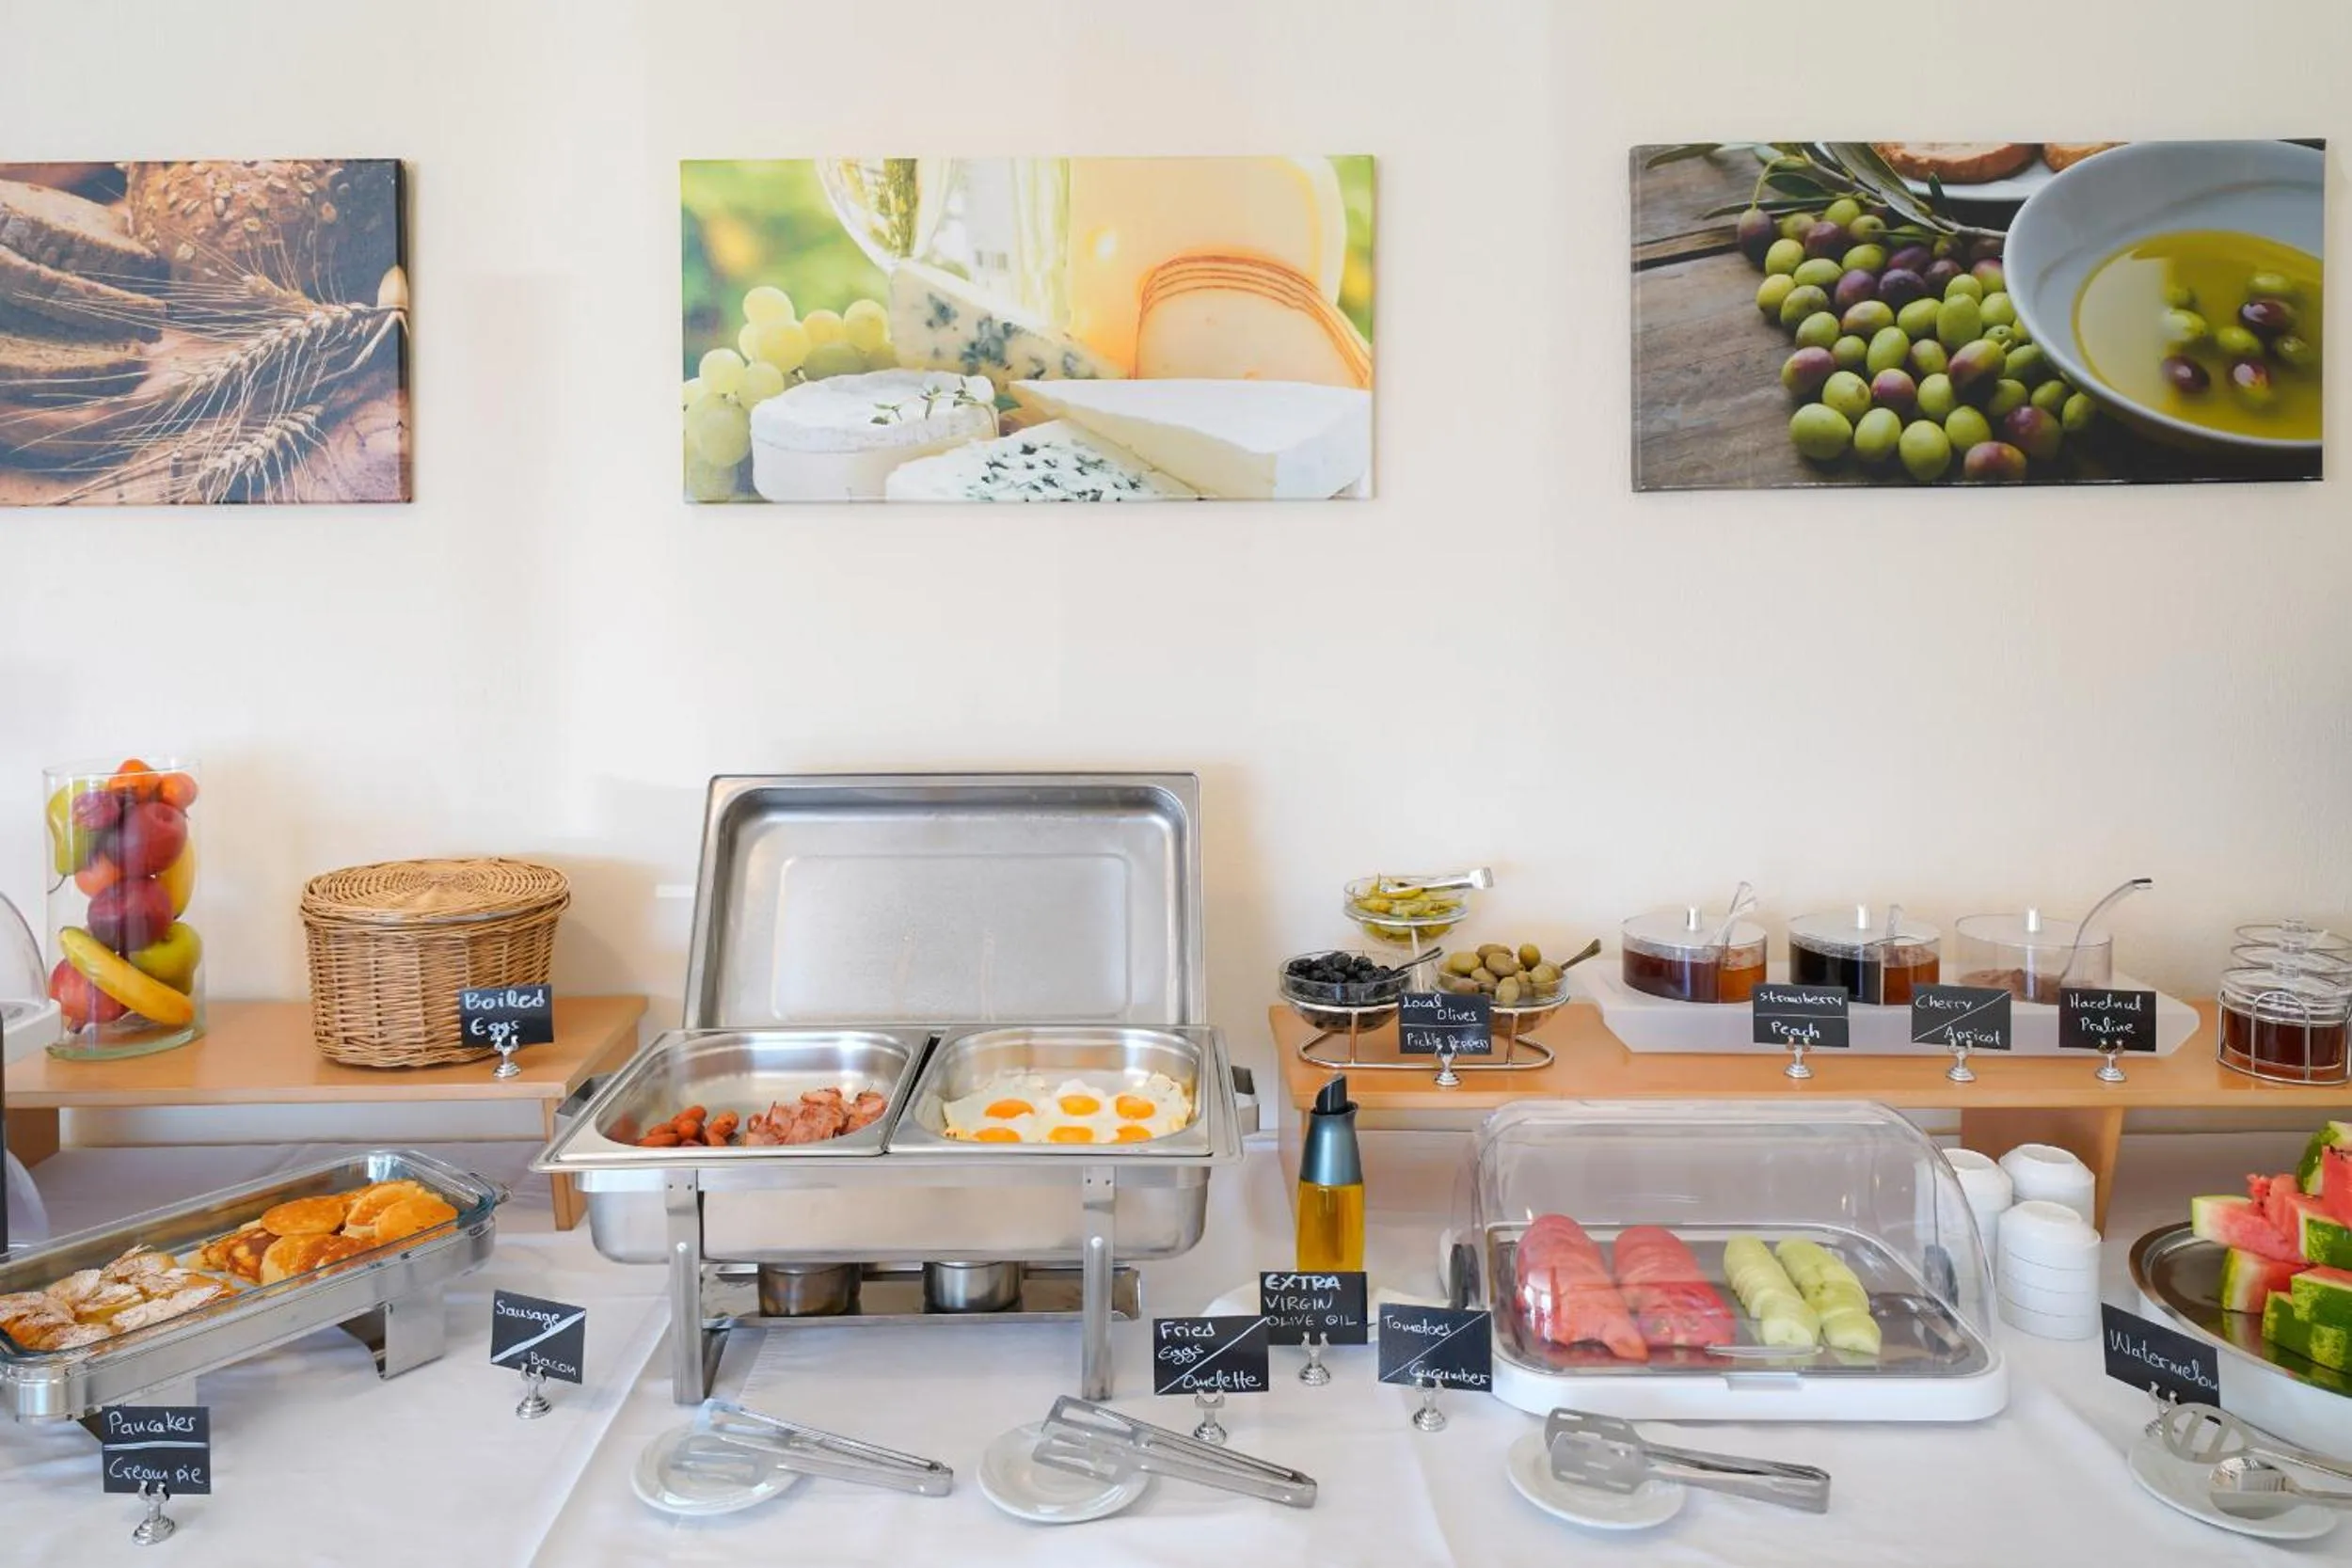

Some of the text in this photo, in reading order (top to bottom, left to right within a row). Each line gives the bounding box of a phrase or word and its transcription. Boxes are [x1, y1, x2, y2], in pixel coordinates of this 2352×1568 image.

[464, 990, 546, 1010] Boiled
[1403, 993, 1442, 1008] Local
[1915, 993, 1973, 1009] Cherry
[2069, 993, 2141, 1011] Hazelnut
[1437, 1008, 1477, 1022] Olives
[470, 1017, 519, 1041] Eggs
[1771, 1021, 1820, 1038] Peach
[2080, 1017, 2136, 1034] Praline
[1407, 1032, 1441, 1047] Pickle
[1944, 1026, 2000, 1045] Apricot
[1264, 1274, 1342, 1291] EXTRA
[1265, 1292, 1333, 1311] VIRGIN
[496, 1300, 561, 1331] Sausage
[1266, 1315, 1358, 1326] OLIVE OIL
[1160, 1322, 1216, 1339] Fried
[1384, 1315, 1451, 1336] Tomatoes
[531, 1352, 577, 1376] Bacon
[1158, 1344, 1204, 1365] Eggs
[2109, 1328, 2218, 1392] Watermelon
[1183, 1370, 1262, 1389] Omelette
[1409, 1360, 1490, 1386] Cucumber
[108, 1411, 197, 1434] Pancakes
[109, 1456, 204, 1484] Cream pie
